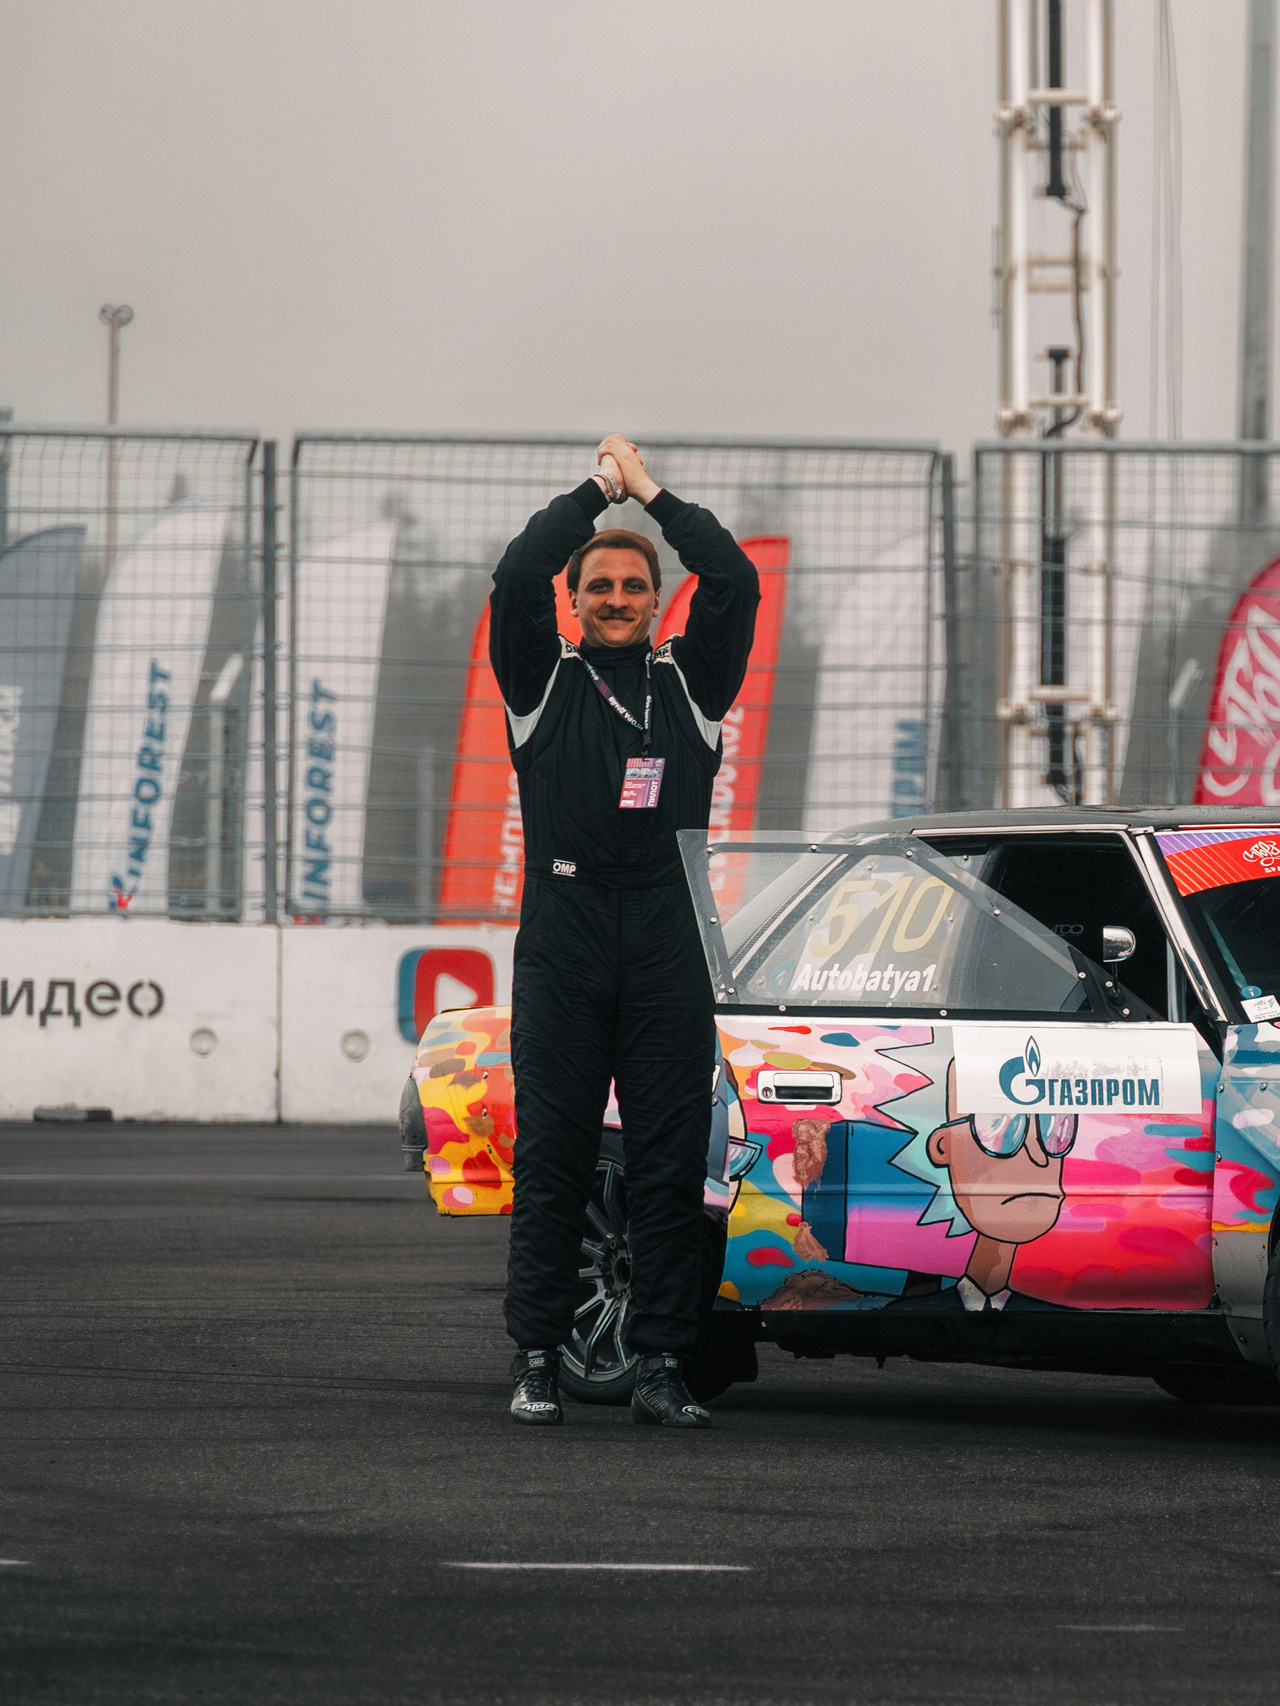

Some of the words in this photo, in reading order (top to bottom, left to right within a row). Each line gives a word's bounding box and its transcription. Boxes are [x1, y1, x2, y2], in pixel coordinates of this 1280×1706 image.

[647, 781, 659, 806] ПИЛОТ
[552, 860, 577, 876] OMP
[809, 872, 957, 957] 510
[791, 963, 937, 998] Autobatya1
[1048, 1079, 1160, 1106] ГАЗПРОМ
